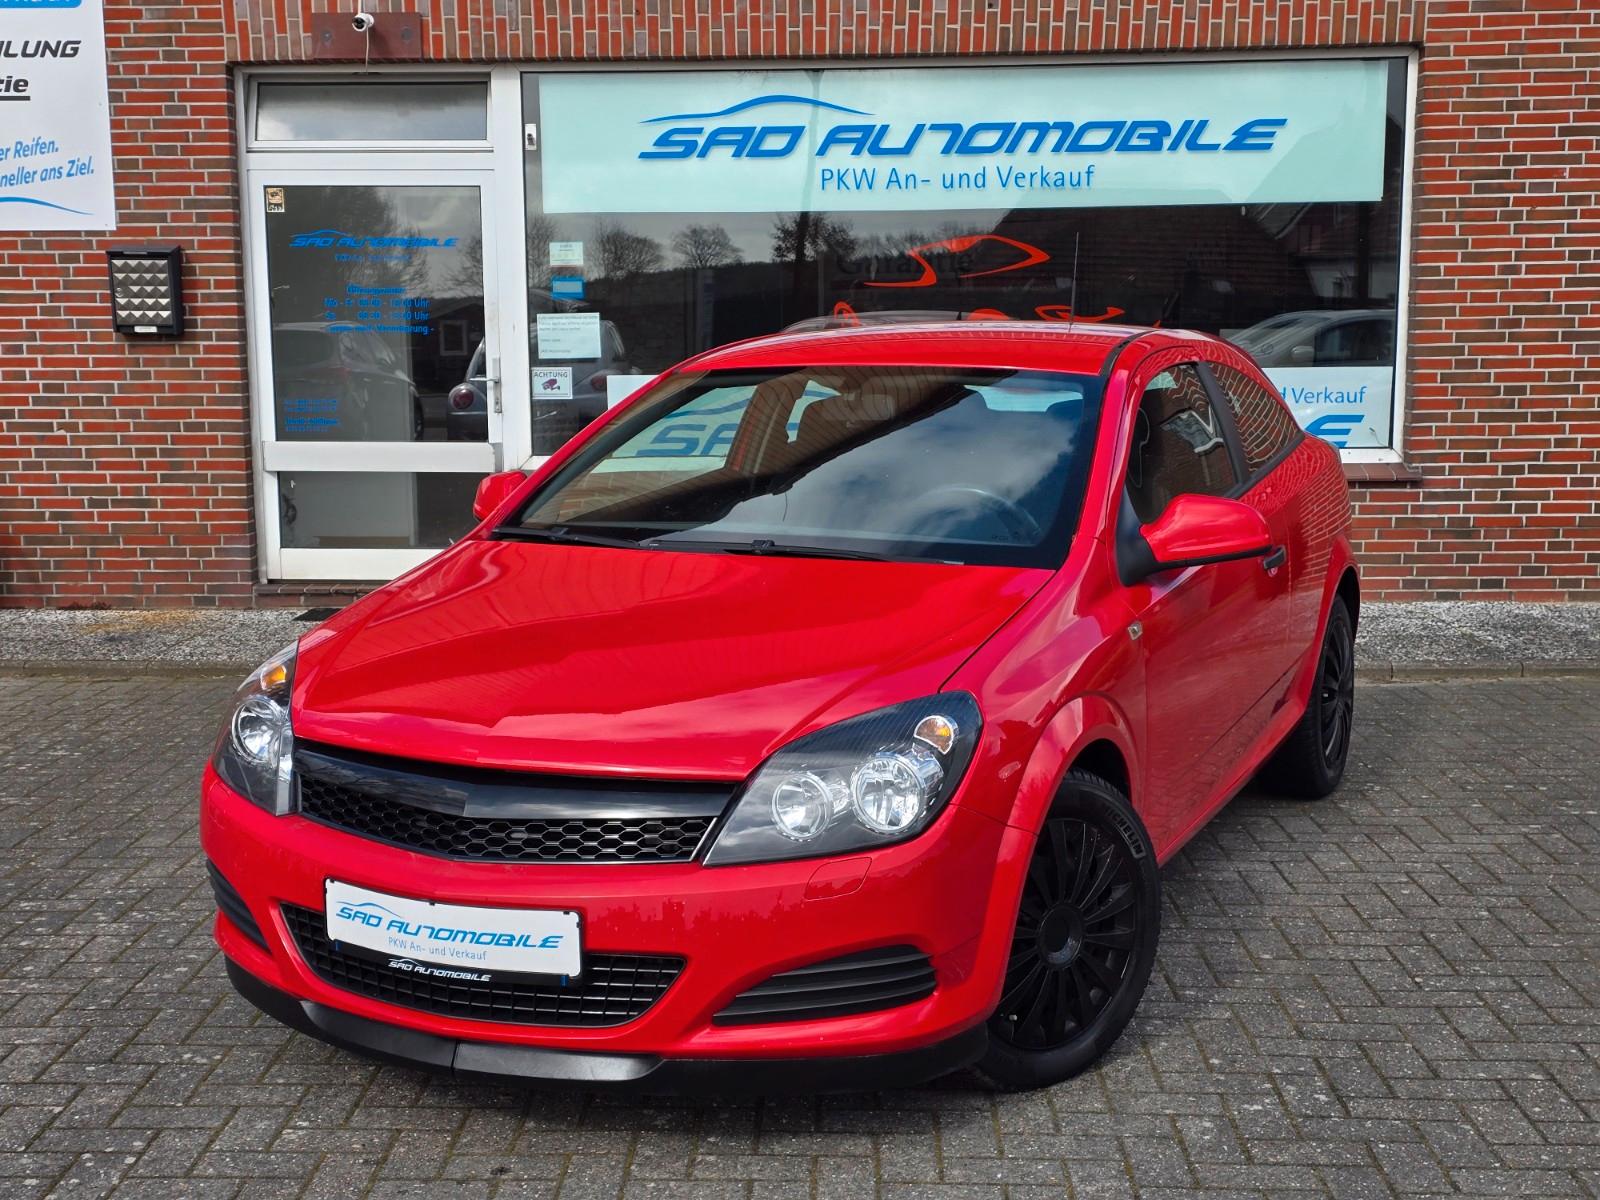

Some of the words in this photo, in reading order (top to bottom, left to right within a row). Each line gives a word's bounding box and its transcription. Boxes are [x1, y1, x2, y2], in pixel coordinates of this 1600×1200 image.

[0, 40, 82, 58] LUNG
[13, 136, 59, 160] Reifen.
[637, 125, 807, 159] SAD
[815, 118, 1288, 157] AUTOMOBILE
[40, 166, 63, 182] ans
[66, 155, 95, 178] Ziel.
[821, 167, 876, 191] PKW
[886, 167, 931, 190] An-
[942, 166, 986, 189] und
[996, 164, 1096, 189] Verkauf
[414, 298, 430, 309] Uhr
[414, 311, 430, 320] Uhr
[533, 371, 568, 379] ACHTUNG
[1291, 386, 1367, 404] Verkauf
[335, 906, 383, 928] SAD
[386, 919, 564, 949] AUTOMOBILE
[388, 936, 407, 949] PKW
[409, 941, 426, 952] An-
[430, 946, 446, 957] und
[448, 947, 487, 960] Verkauf
[388, 961, 414, 971] SAD
[414, 966, 492, 982] AUTOMOBILE
